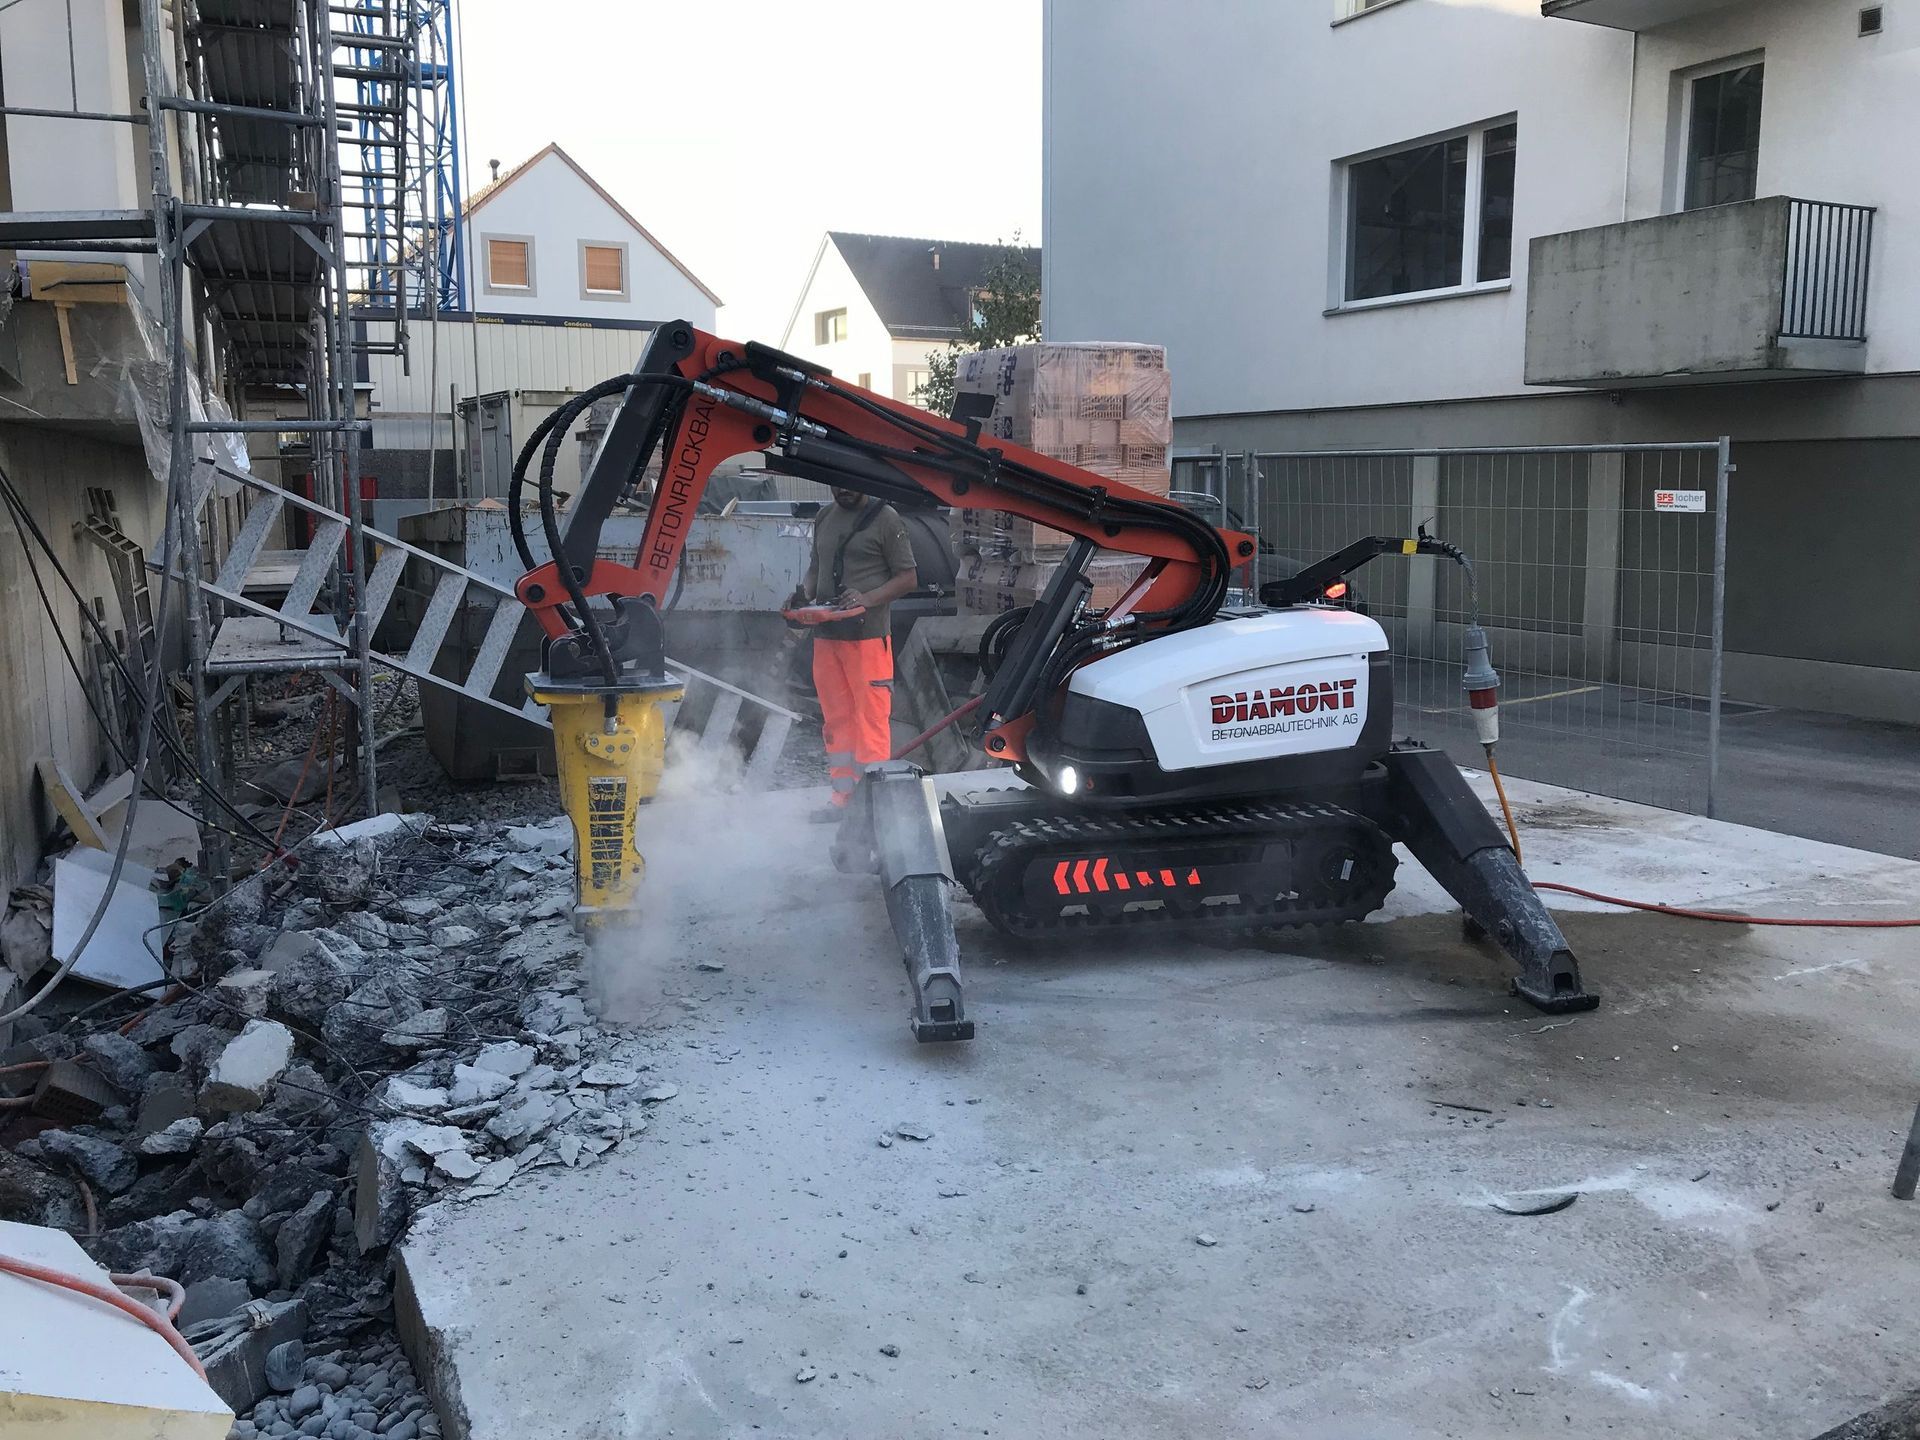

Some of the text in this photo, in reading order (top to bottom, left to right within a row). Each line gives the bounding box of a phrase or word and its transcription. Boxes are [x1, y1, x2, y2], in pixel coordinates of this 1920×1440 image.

[650, 397, 717, 570] BETONRÜCKBAU
[1657, 493, 1704, 502] SFS locher
[1210, 679, 1357, 725] DIAMONT
[1212, 713, 1358, 741] BETONABBAUTECHNIK AG
